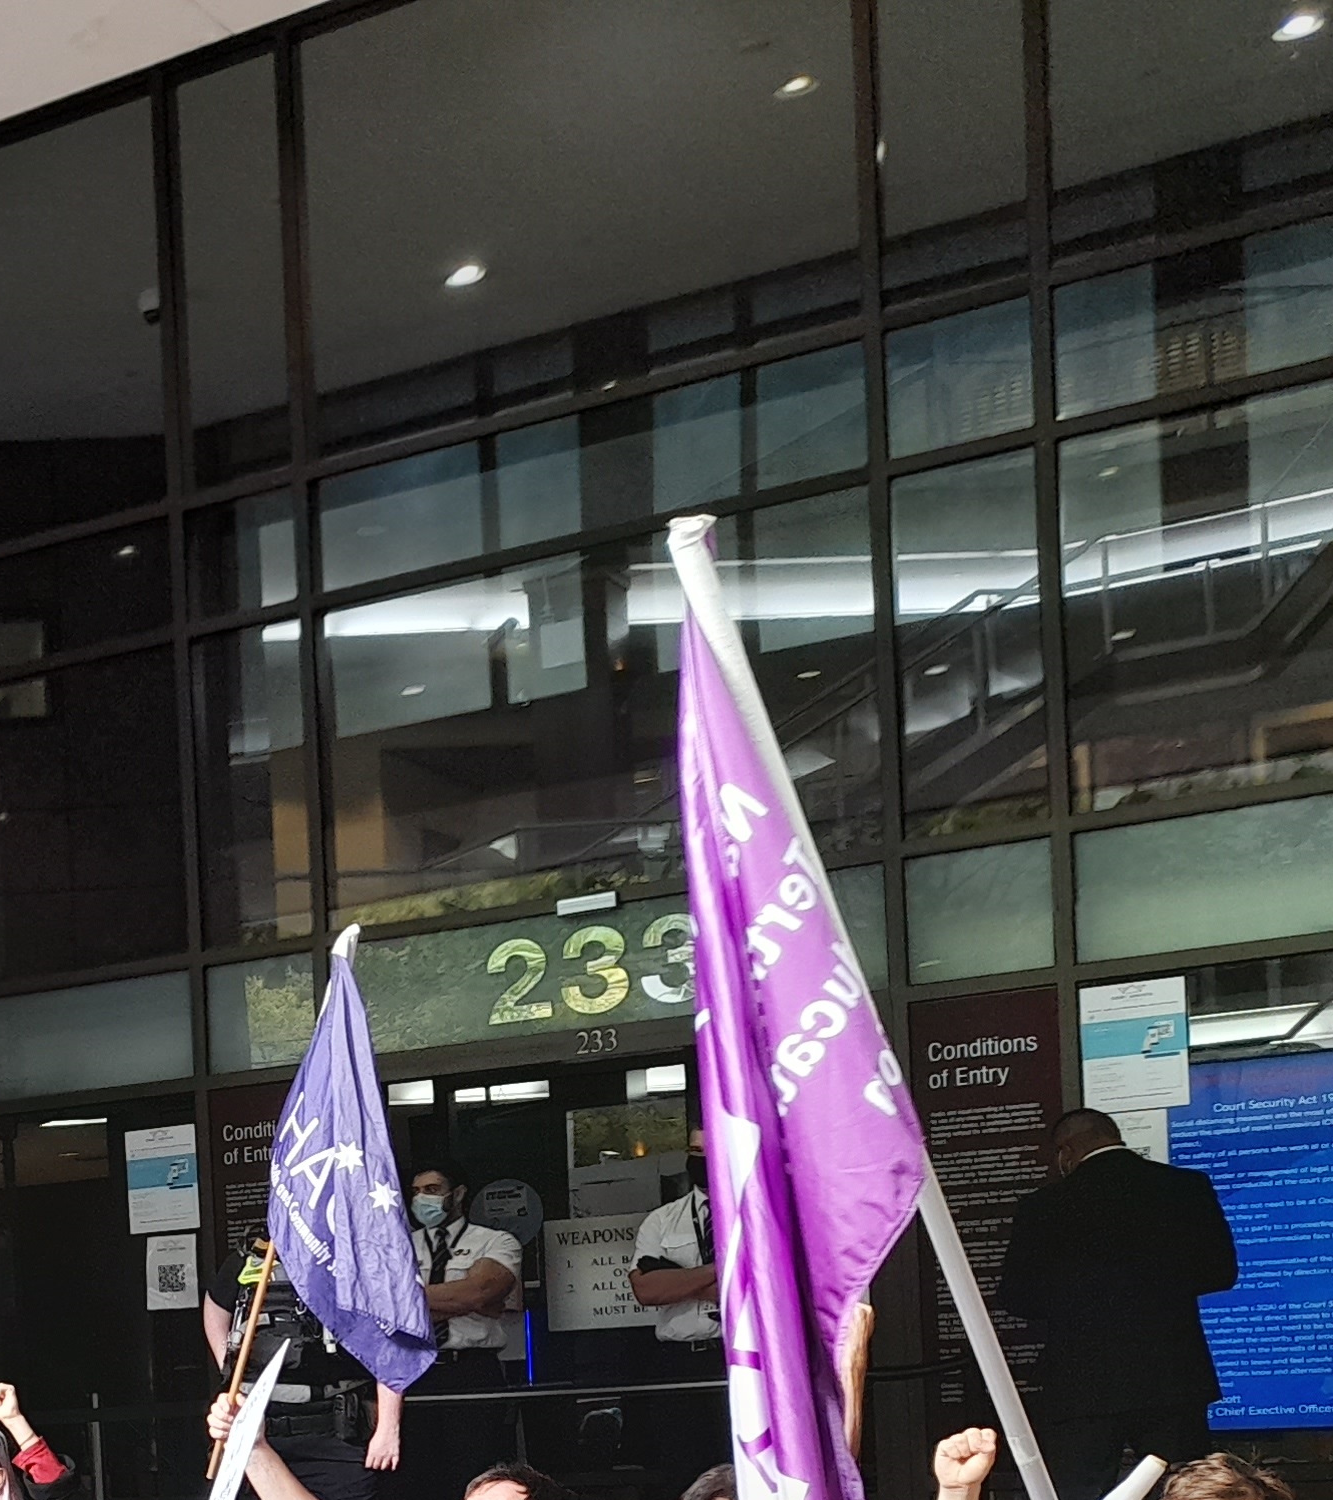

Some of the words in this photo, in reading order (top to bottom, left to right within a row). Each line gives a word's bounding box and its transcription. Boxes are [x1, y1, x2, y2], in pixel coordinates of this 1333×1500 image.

[487, 913, 698, 1025] 233
[576, 1028, 618, 1054] 233
[928, 1036, 1038, 1062] Conditions
[929, 1069, 949, 1089] of
[955, 1066, 1009, 1086] Entry
[1213, 1103, 1245, 1112] Court
[1249, 1098, 1295, 1109] Security
[1299, 1095, 1317, 1104] Act
[223, 1121, 277, 1142] Conditi
[224, 1151, 239, 1165] of
[244, 1148, 273, 1164] Entr
[289, 1202, 332, 1265] Community
[556, 1228, 633, 1245] WEAPONS
[591, 1256, 615, 1266] ALL
[592, 1282, 616, 1290] ALL
[593, 1305, 627, 1315] MUST
